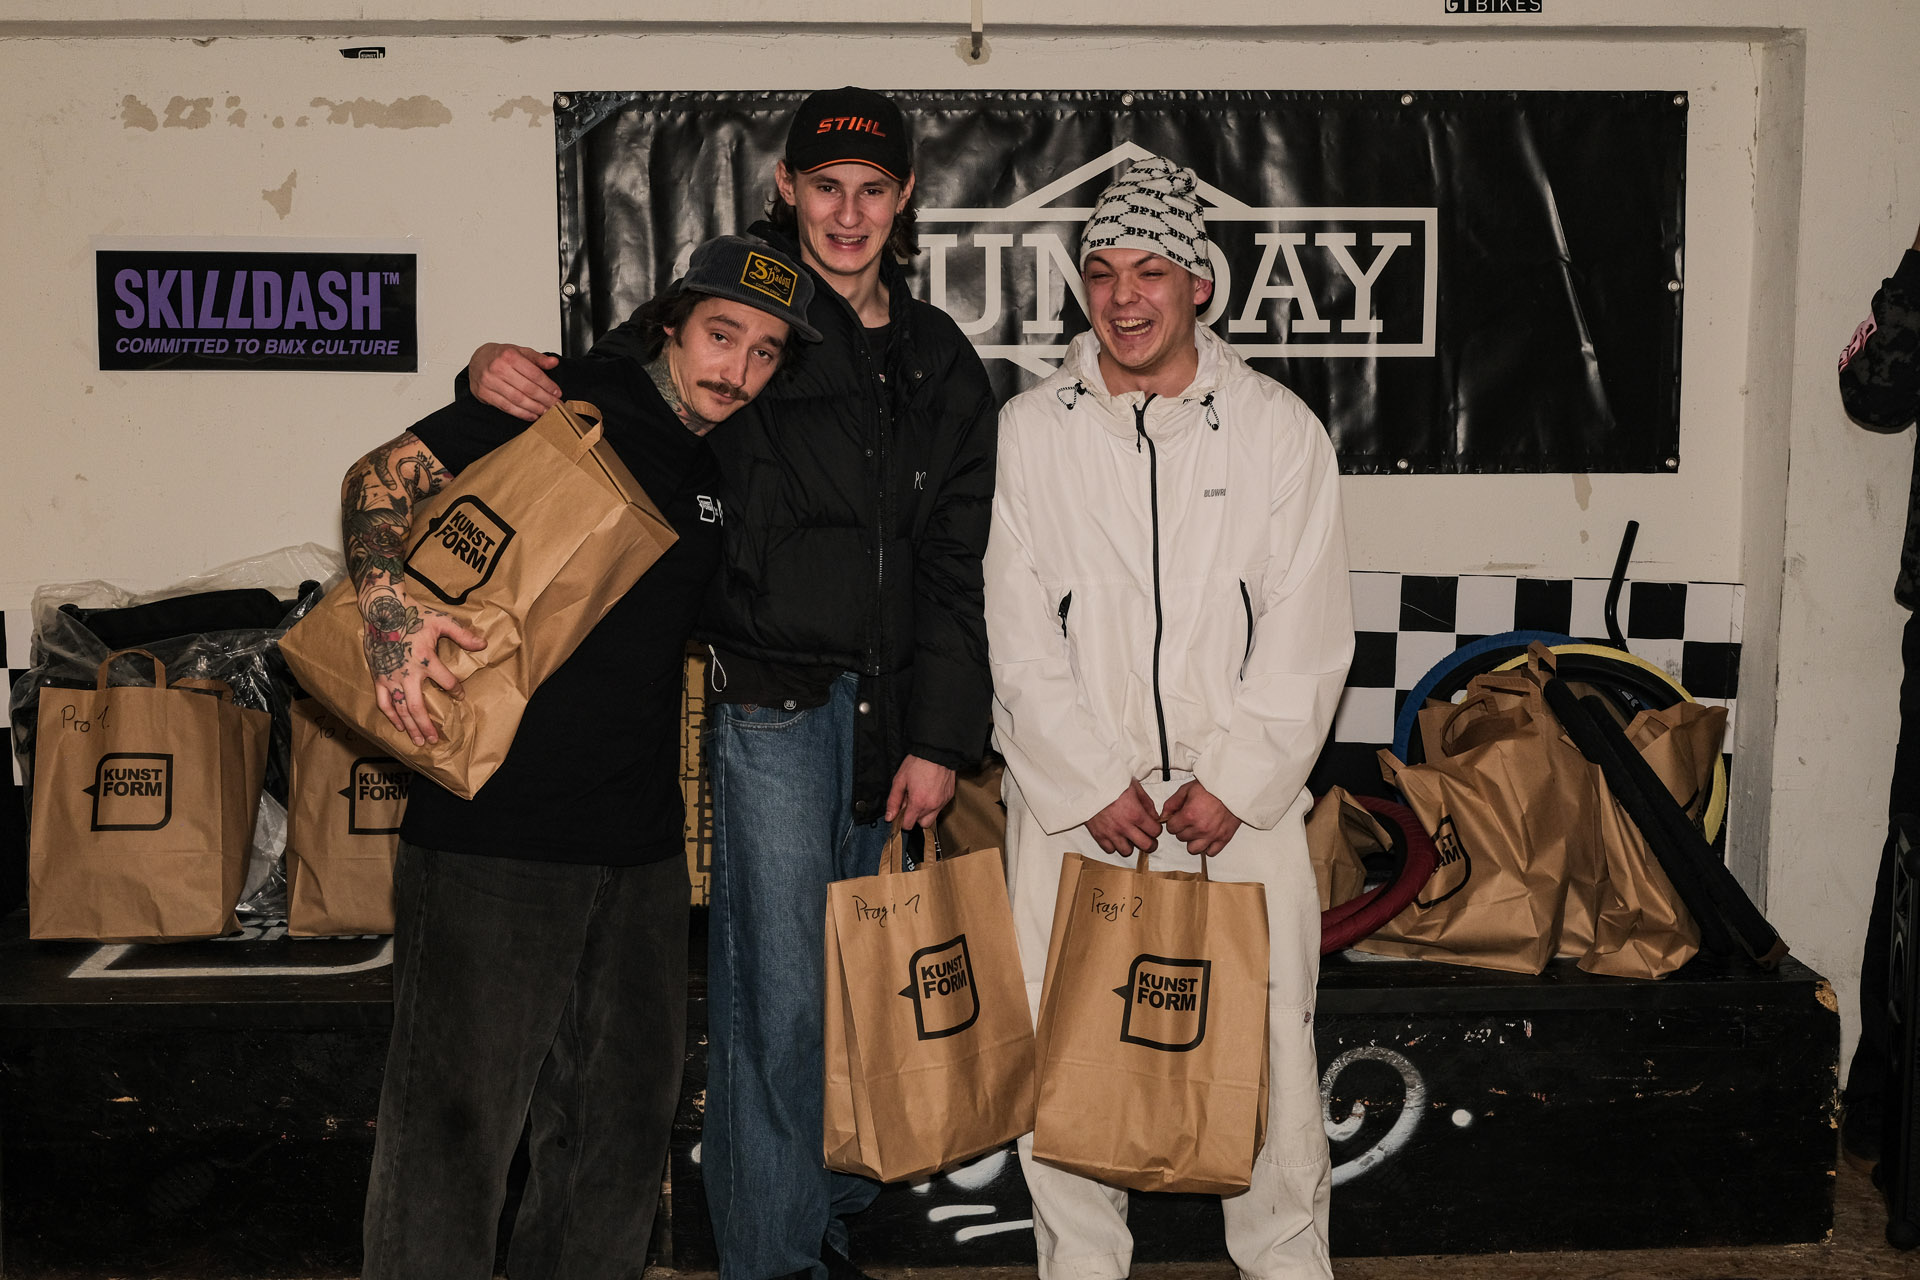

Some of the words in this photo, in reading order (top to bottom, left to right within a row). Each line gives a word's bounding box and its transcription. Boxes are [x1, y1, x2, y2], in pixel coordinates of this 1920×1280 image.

[816, 116, 886, 137] STIHL
[901, 233, 1411, 334] UNAY
[114, 268, 381, 331] SKILLDASH
[115, 337, 228, 354] COMMITTED
[234, 338, 260, 354] TO
[264, 339, 306, 355] BMX
[311, 340, 400, 356] CULTURE
[449, 510, 496, 553] KUNST
[434, 524, 488, 574] FORM
[61, 704, 91, 733] Pro
[104, 768, 163, 781] KUNST
[103, 781, 162, 797] FORM
[1132, 897, 1143, 918] 2
[921, 954, 962, 981] KUNST
[923, 970, 967, 999] FORM
[1139, 971, 1198, 993] KUNST
[1137, 986, 1197, 1012] FORM
